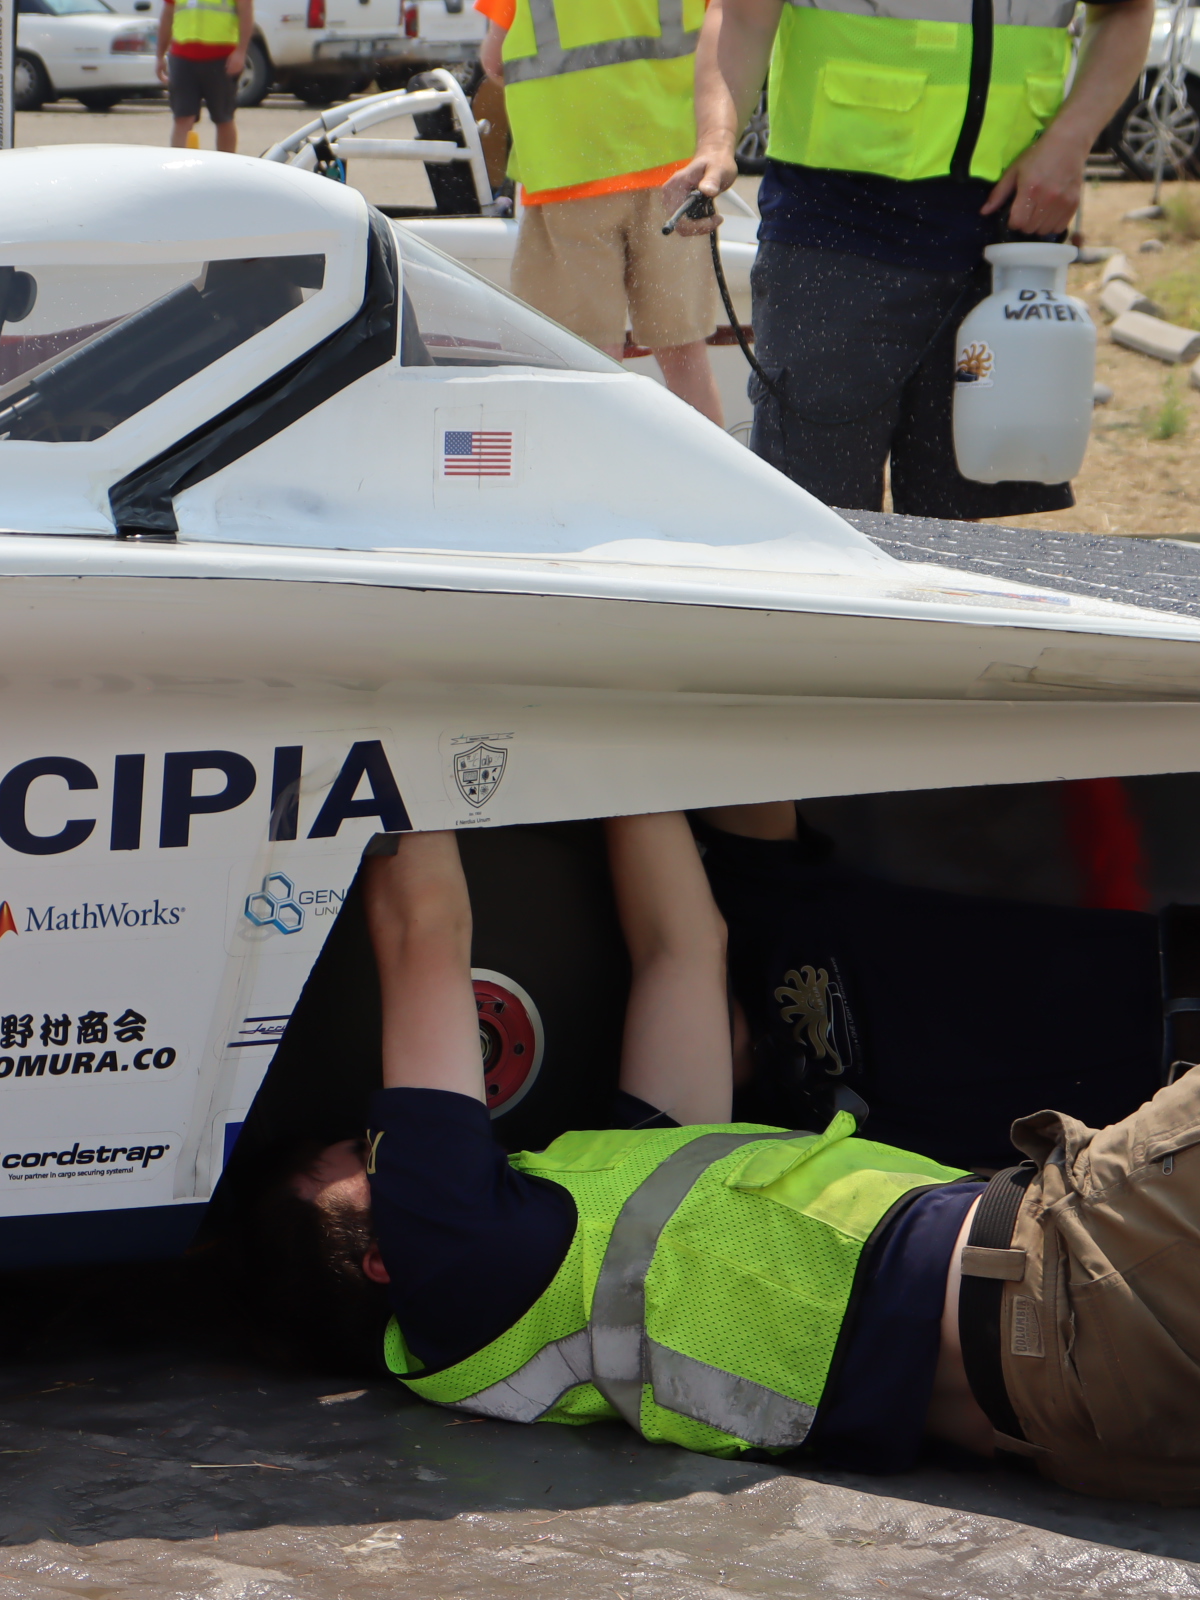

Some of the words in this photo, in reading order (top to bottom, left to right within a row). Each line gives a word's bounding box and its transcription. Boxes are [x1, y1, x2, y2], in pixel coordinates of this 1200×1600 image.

[24, 899, 182, 932] MathWorks
[0, 1008, 147, 1049] 野村商会
[1, 1142, 166, 1169] cordstrap
[8, 1173, 24, 1181] Your
[24, 1171, 49, 1181] partner
[57, 1171, 76, 1179] cargo
[77, 1168, 105, 1177] securing
[105, 1166, 134, 1175] systems!
[1014, 1299, 1028, 1352] COLUMBIA
